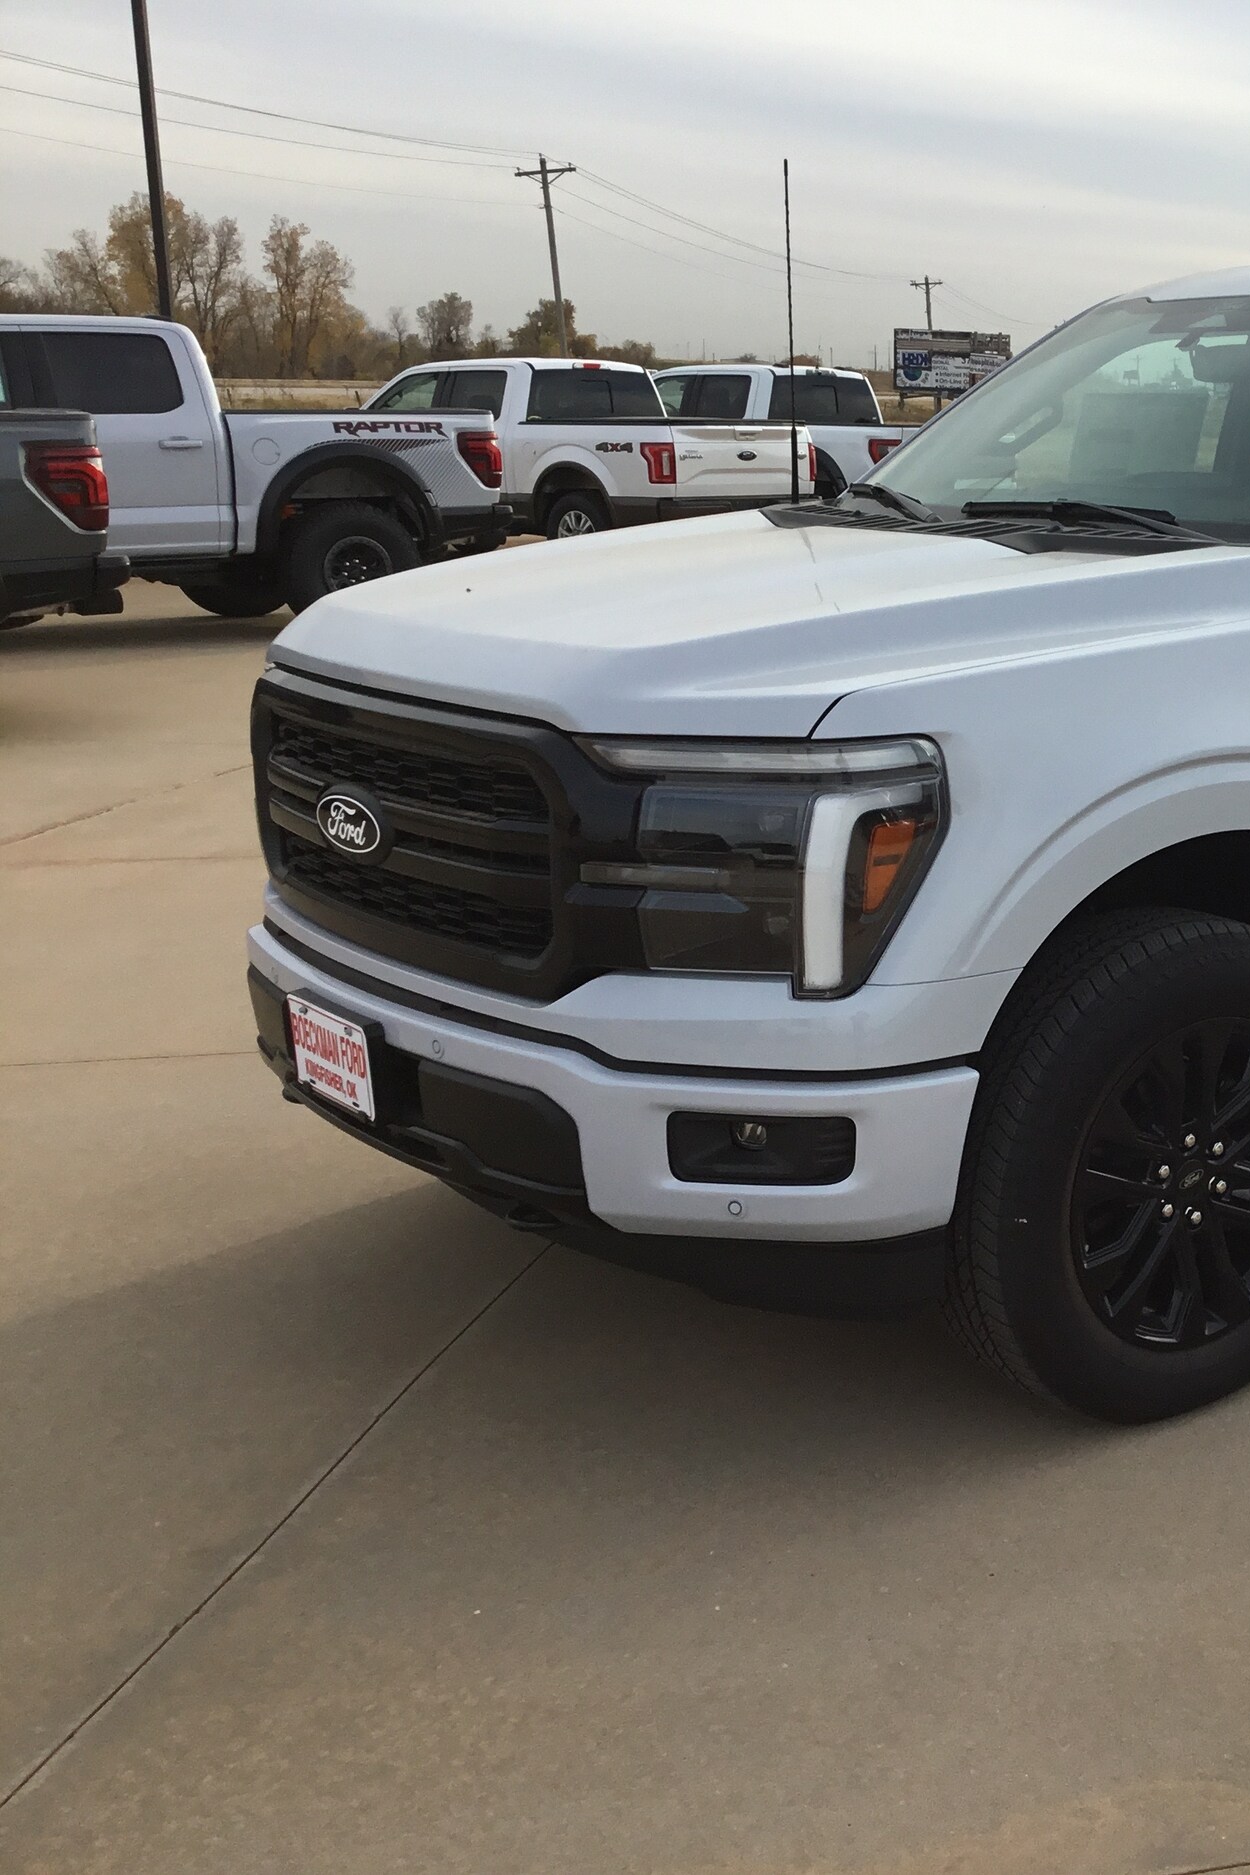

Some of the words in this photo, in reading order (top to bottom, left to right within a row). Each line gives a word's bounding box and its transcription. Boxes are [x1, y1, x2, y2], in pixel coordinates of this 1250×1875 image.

[332, 421, 449, 439] RAPTOR
[327, 801, 367, 846] Ford
[339, 1035, 367, 1079] FORD
